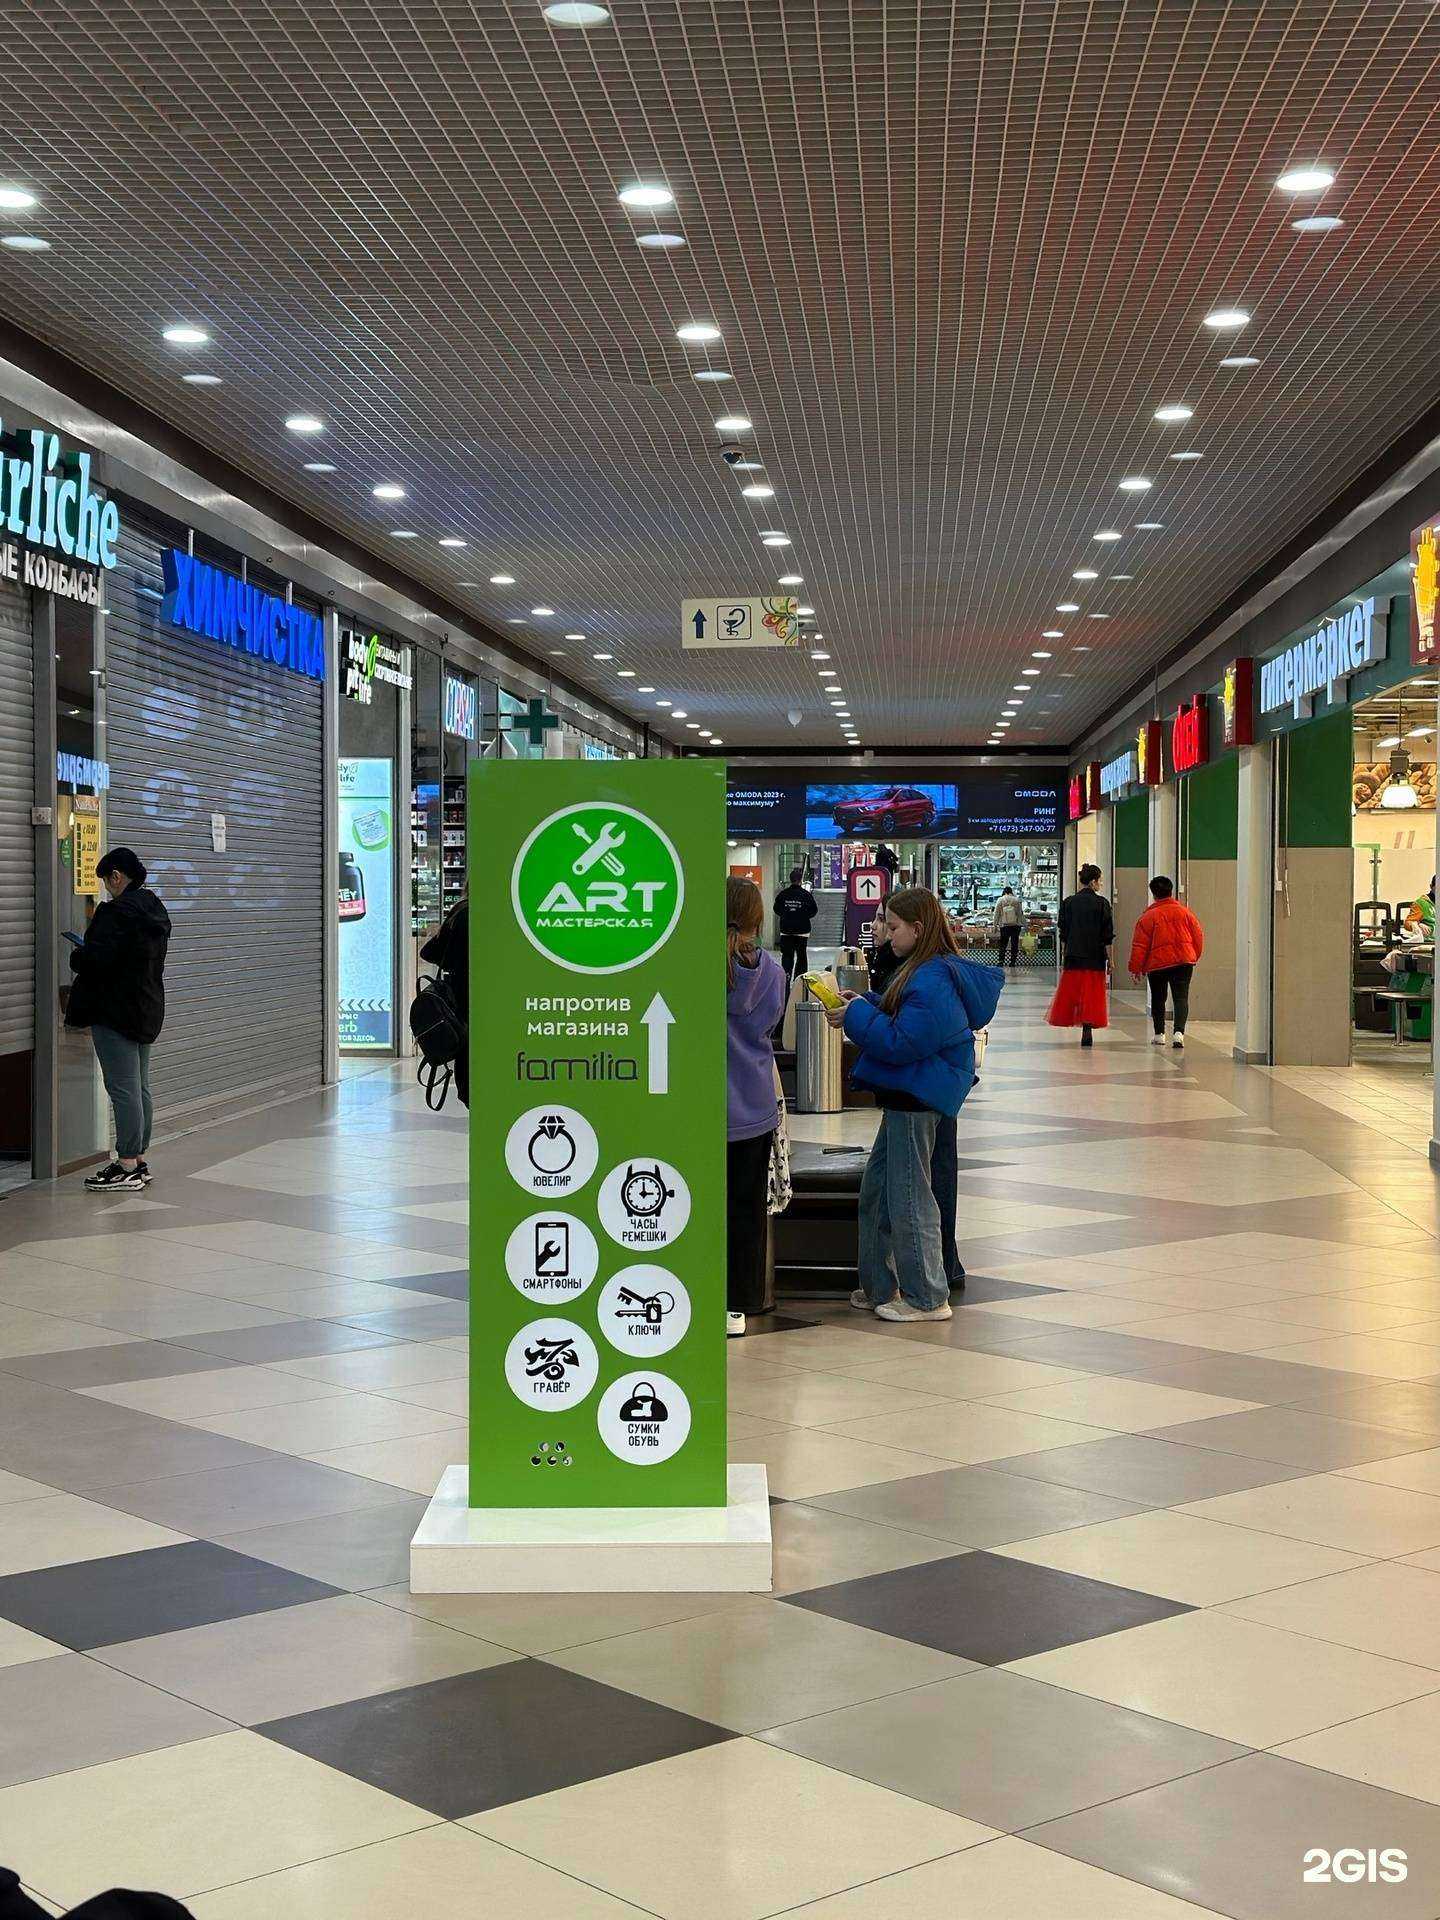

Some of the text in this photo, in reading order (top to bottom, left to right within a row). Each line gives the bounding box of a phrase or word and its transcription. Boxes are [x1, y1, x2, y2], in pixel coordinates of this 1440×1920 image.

[0, 417, 119, 570] rliche
[172, 549, 325, 681] ХИМЧИСТКА
[1261, 597, 1375, 719] гипермаркет
[1034, 807, 1056, 815] РИНГ
[999, 825, 1018, 833] (473)
[536, 881, 667, 912] ART
[536, 918, 653, 928] МАСТЕРСКАЯ
[526, 996, 631, 1016] напротив
[527, 1021, 629, 1036] магазина
[517, 1051, 639, 1081] familia
[533, 1175, 571, 1187] ЮВЕЛИР
[630, 1218, 658, 1229] ЧАСЫ
[622, 1231, 667, 1242] РЕМЕШКИ
[523, 1278, 582, 1289] СМАРТФОНЫ
[628, 1325, 661, 1336] КЛЮЧИ
[533, 1380, 571, 1393] ГРАВЁР
[628, 1423, 660, 1434] СУМКИ
[628, 1435, 659, 1447] ОБУВЬ
